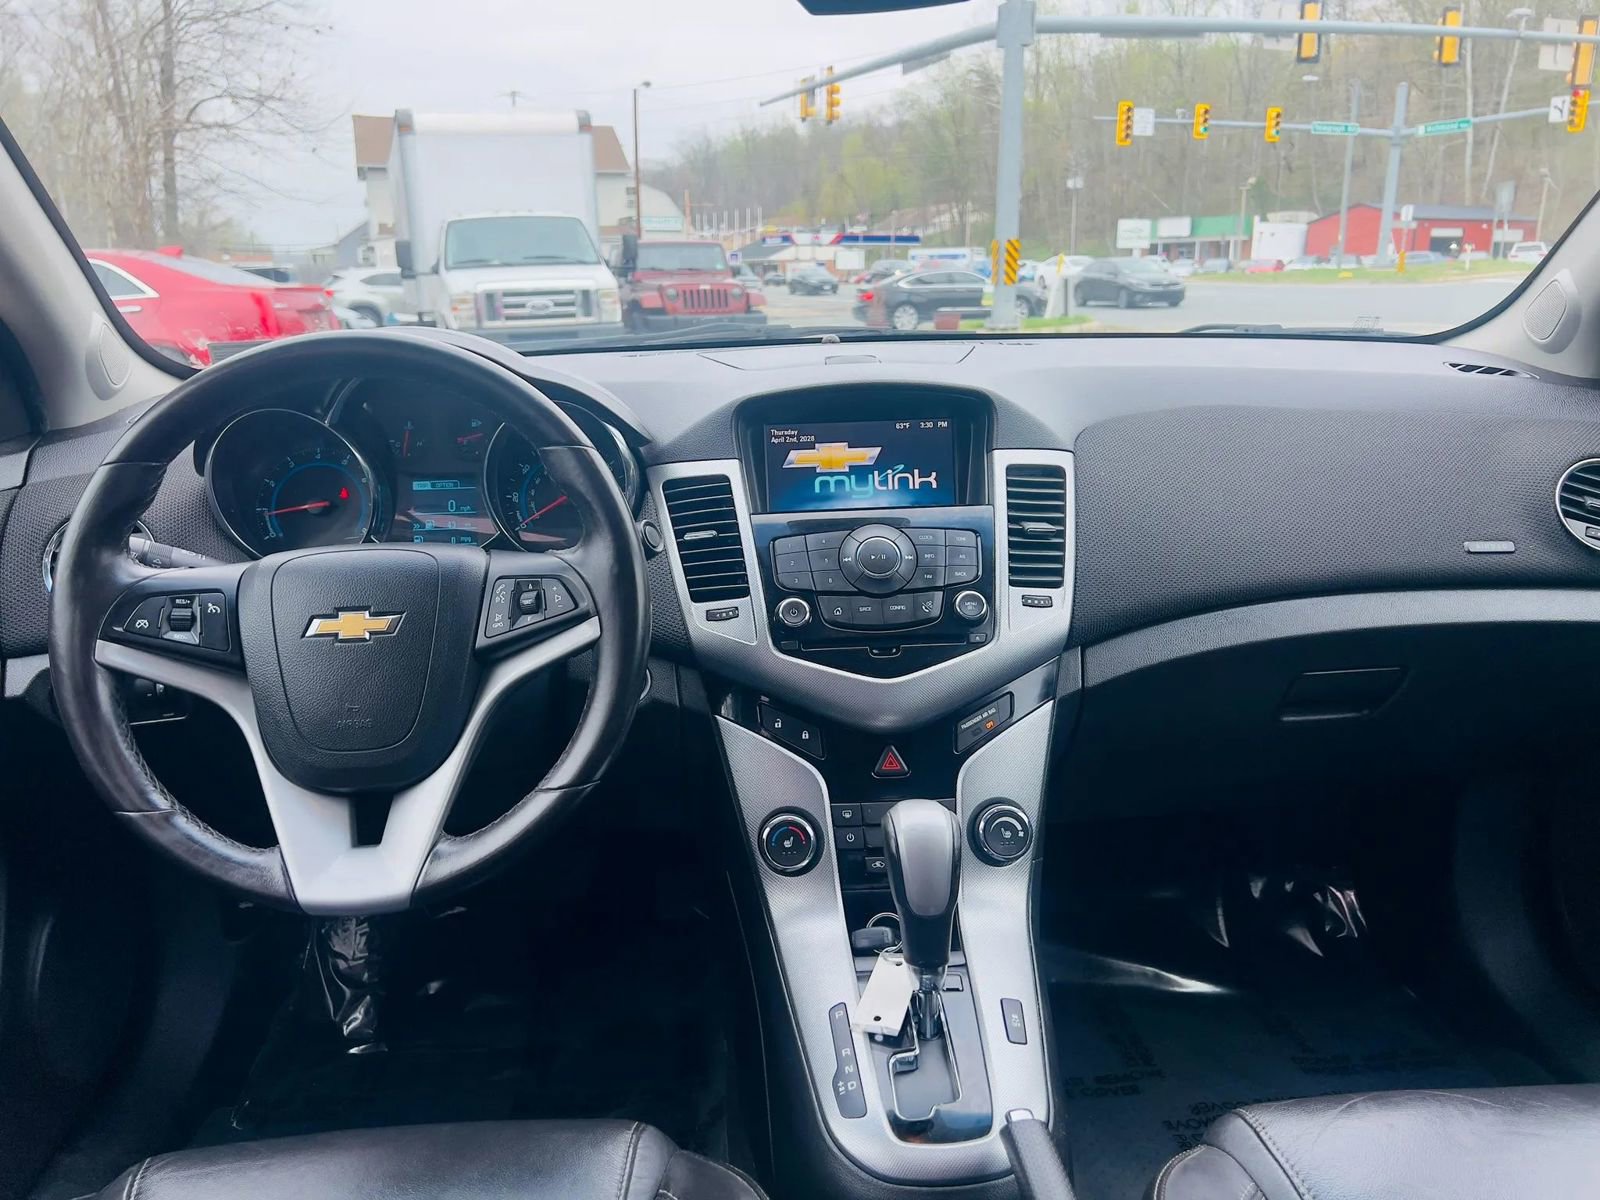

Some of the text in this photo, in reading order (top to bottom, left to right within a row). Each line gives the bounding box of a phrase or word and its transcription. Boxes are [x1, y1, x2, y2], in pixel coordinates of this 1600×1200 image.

[770, 429, 798, 437] Thursday
[770, 436, 785, 444] April
[785, 435, 799, 443] 2nd,
[448, 500, 456, 512] 0
[961, 714, 982, 729] PASSENGER
[988, 707, 996, 715] BAG
[835, 1010, 844, 1019] P
[842, 1047, 851, 1057] R
[844, 1065, 854, 1075] N
[847, 1080, 857, 1090] D
